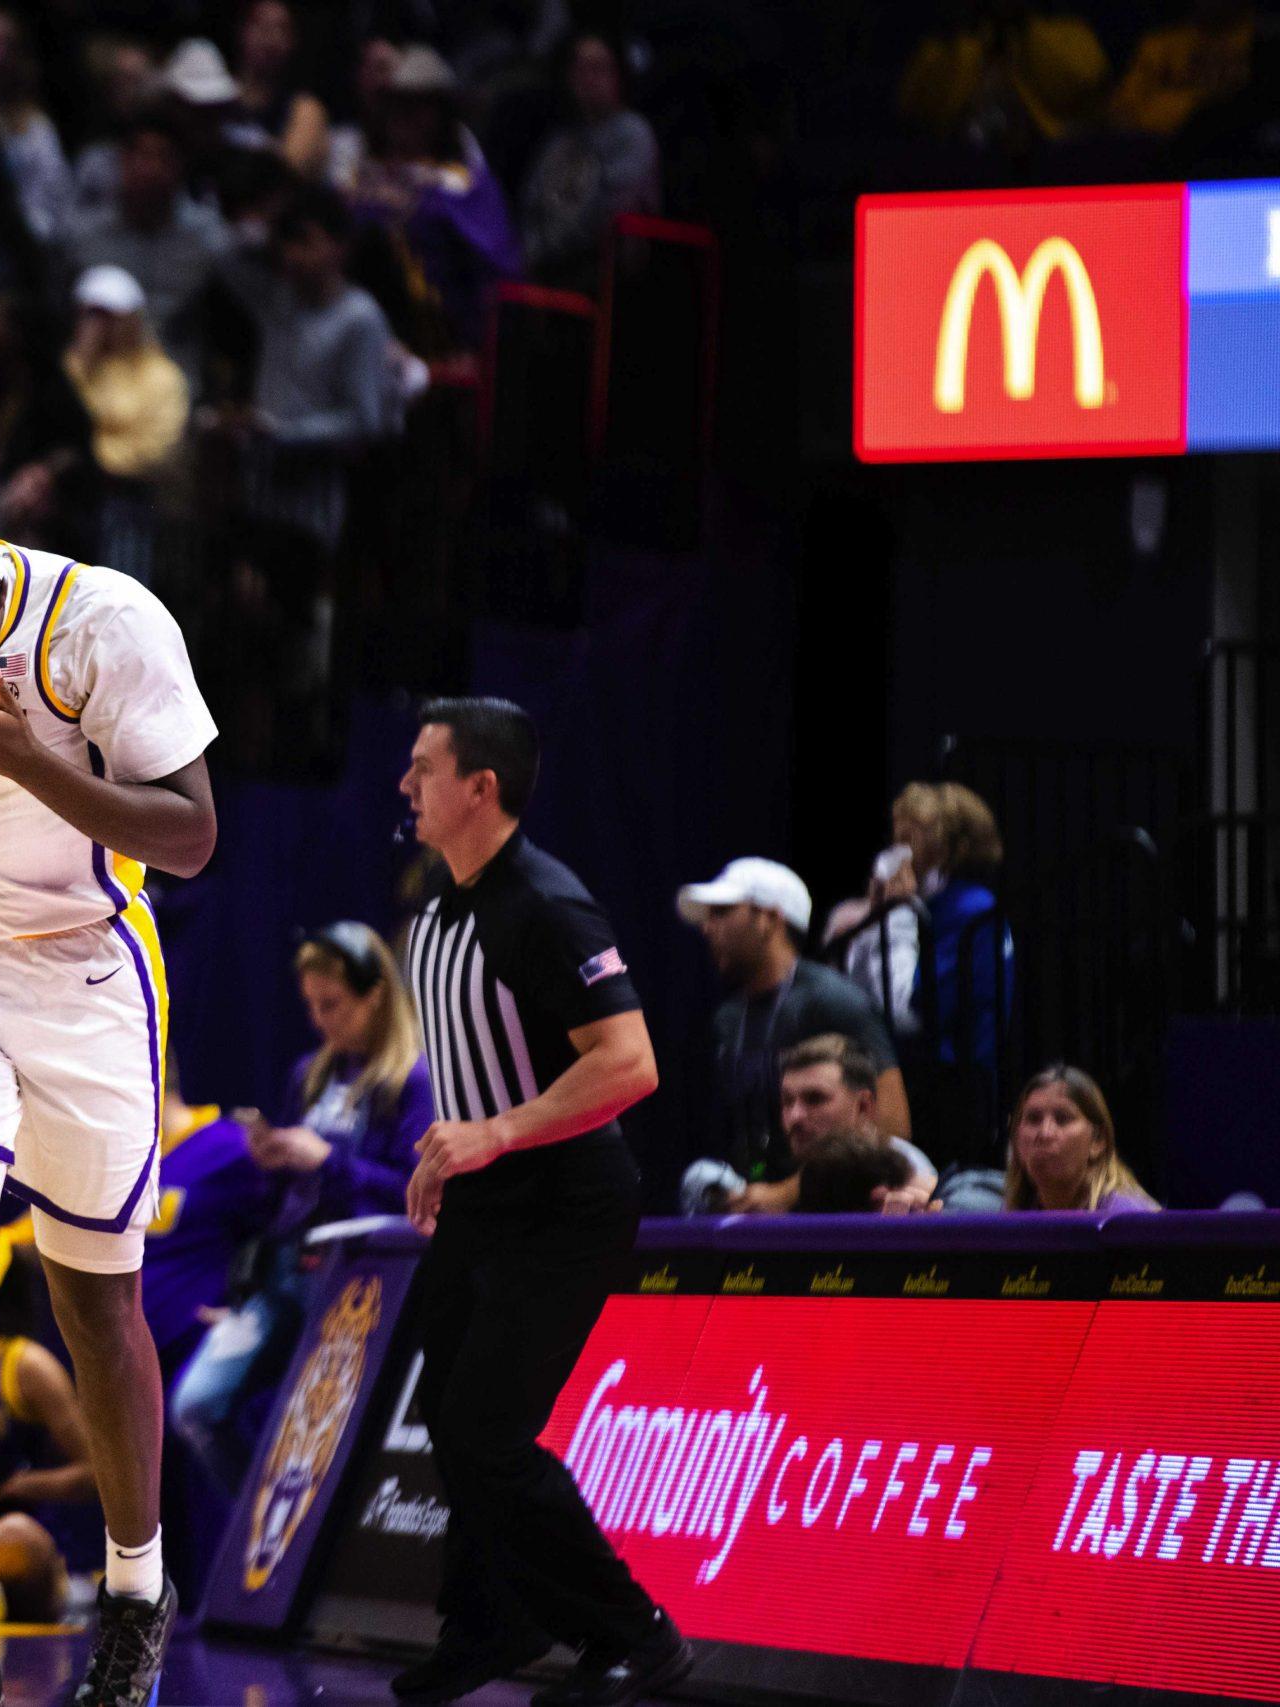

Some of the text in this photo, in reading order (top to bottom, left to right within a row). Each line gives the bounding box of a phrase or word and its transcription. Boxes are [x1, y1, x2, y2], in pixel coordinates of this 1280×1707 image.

[563, 1358, 788, 1586] Community
[766, 1434, 993, 1541] COFFEE
[1052, 1449, 1213, 1560] TASTE
